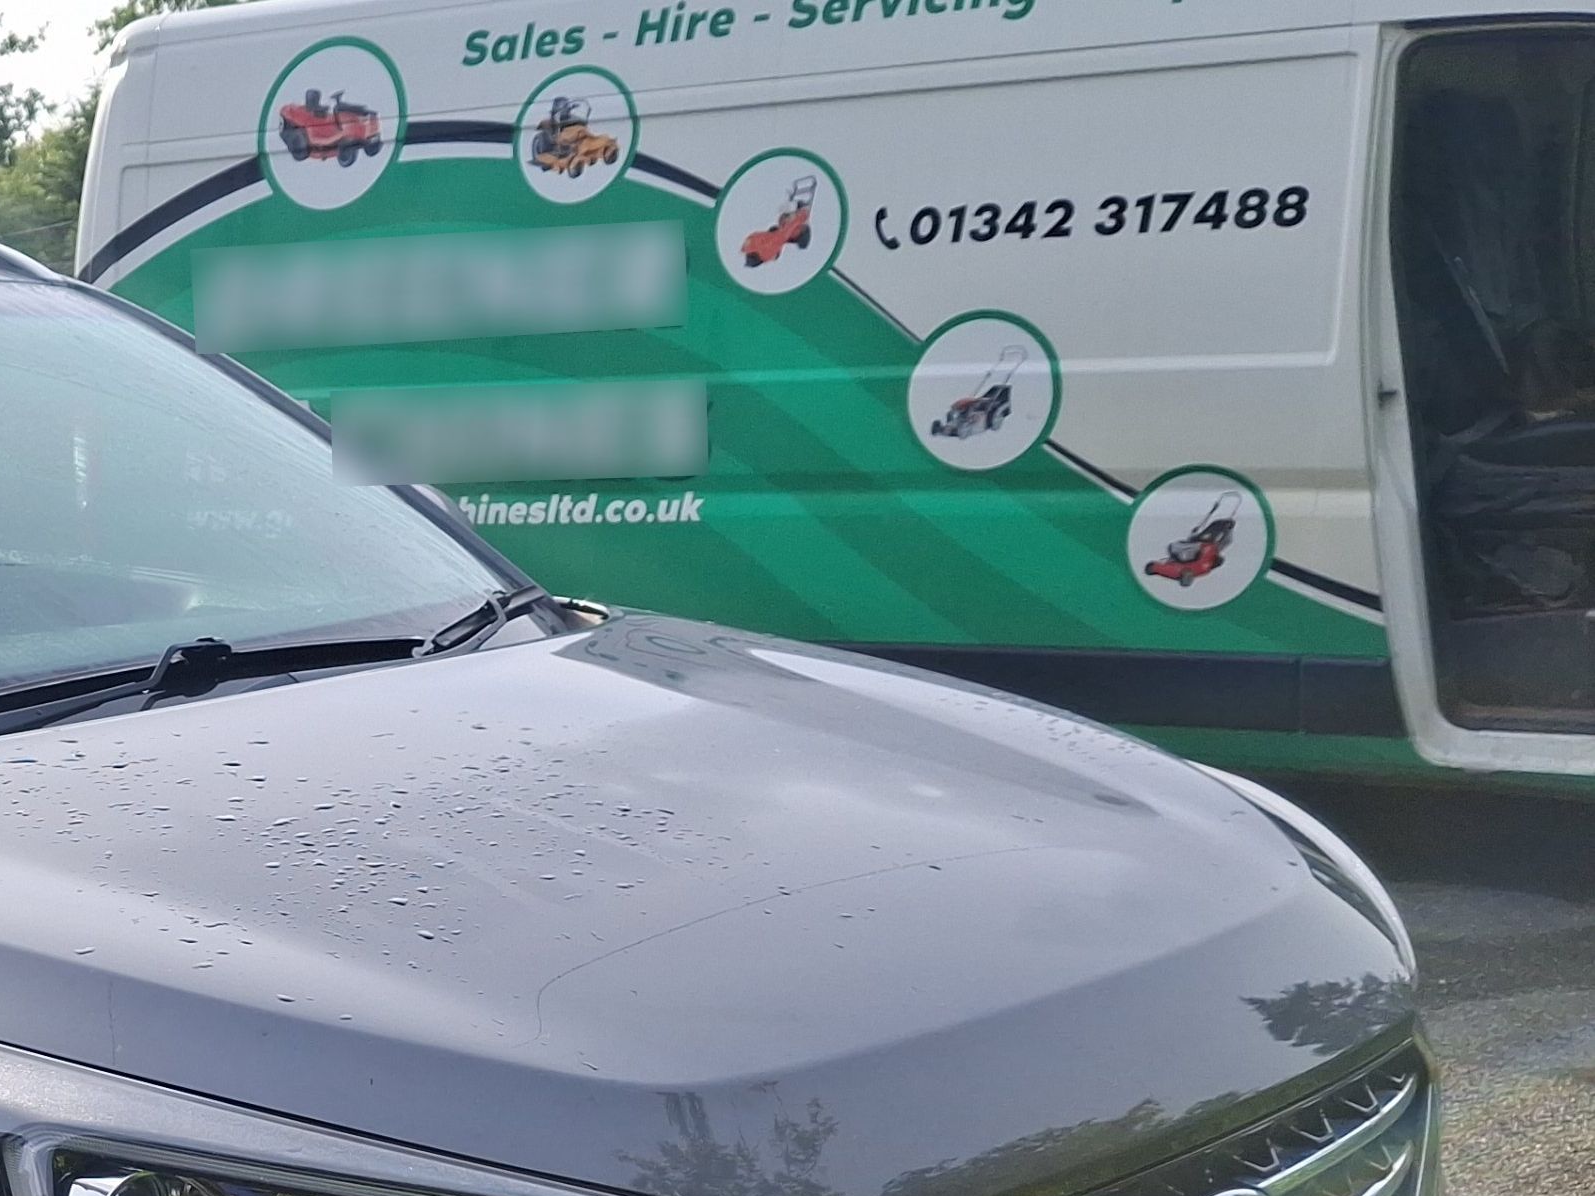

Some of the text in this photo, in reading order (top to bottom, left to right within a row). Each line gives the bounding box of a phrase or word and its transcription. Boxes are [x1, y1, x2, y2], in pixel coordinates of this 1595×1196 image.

[462, 22, 586, 66] Sales
[635, 0, 736, 46] Hire
[788, 0, 1038, 29] Servcg
[909, 186, 1310, 245] 01342 317488
